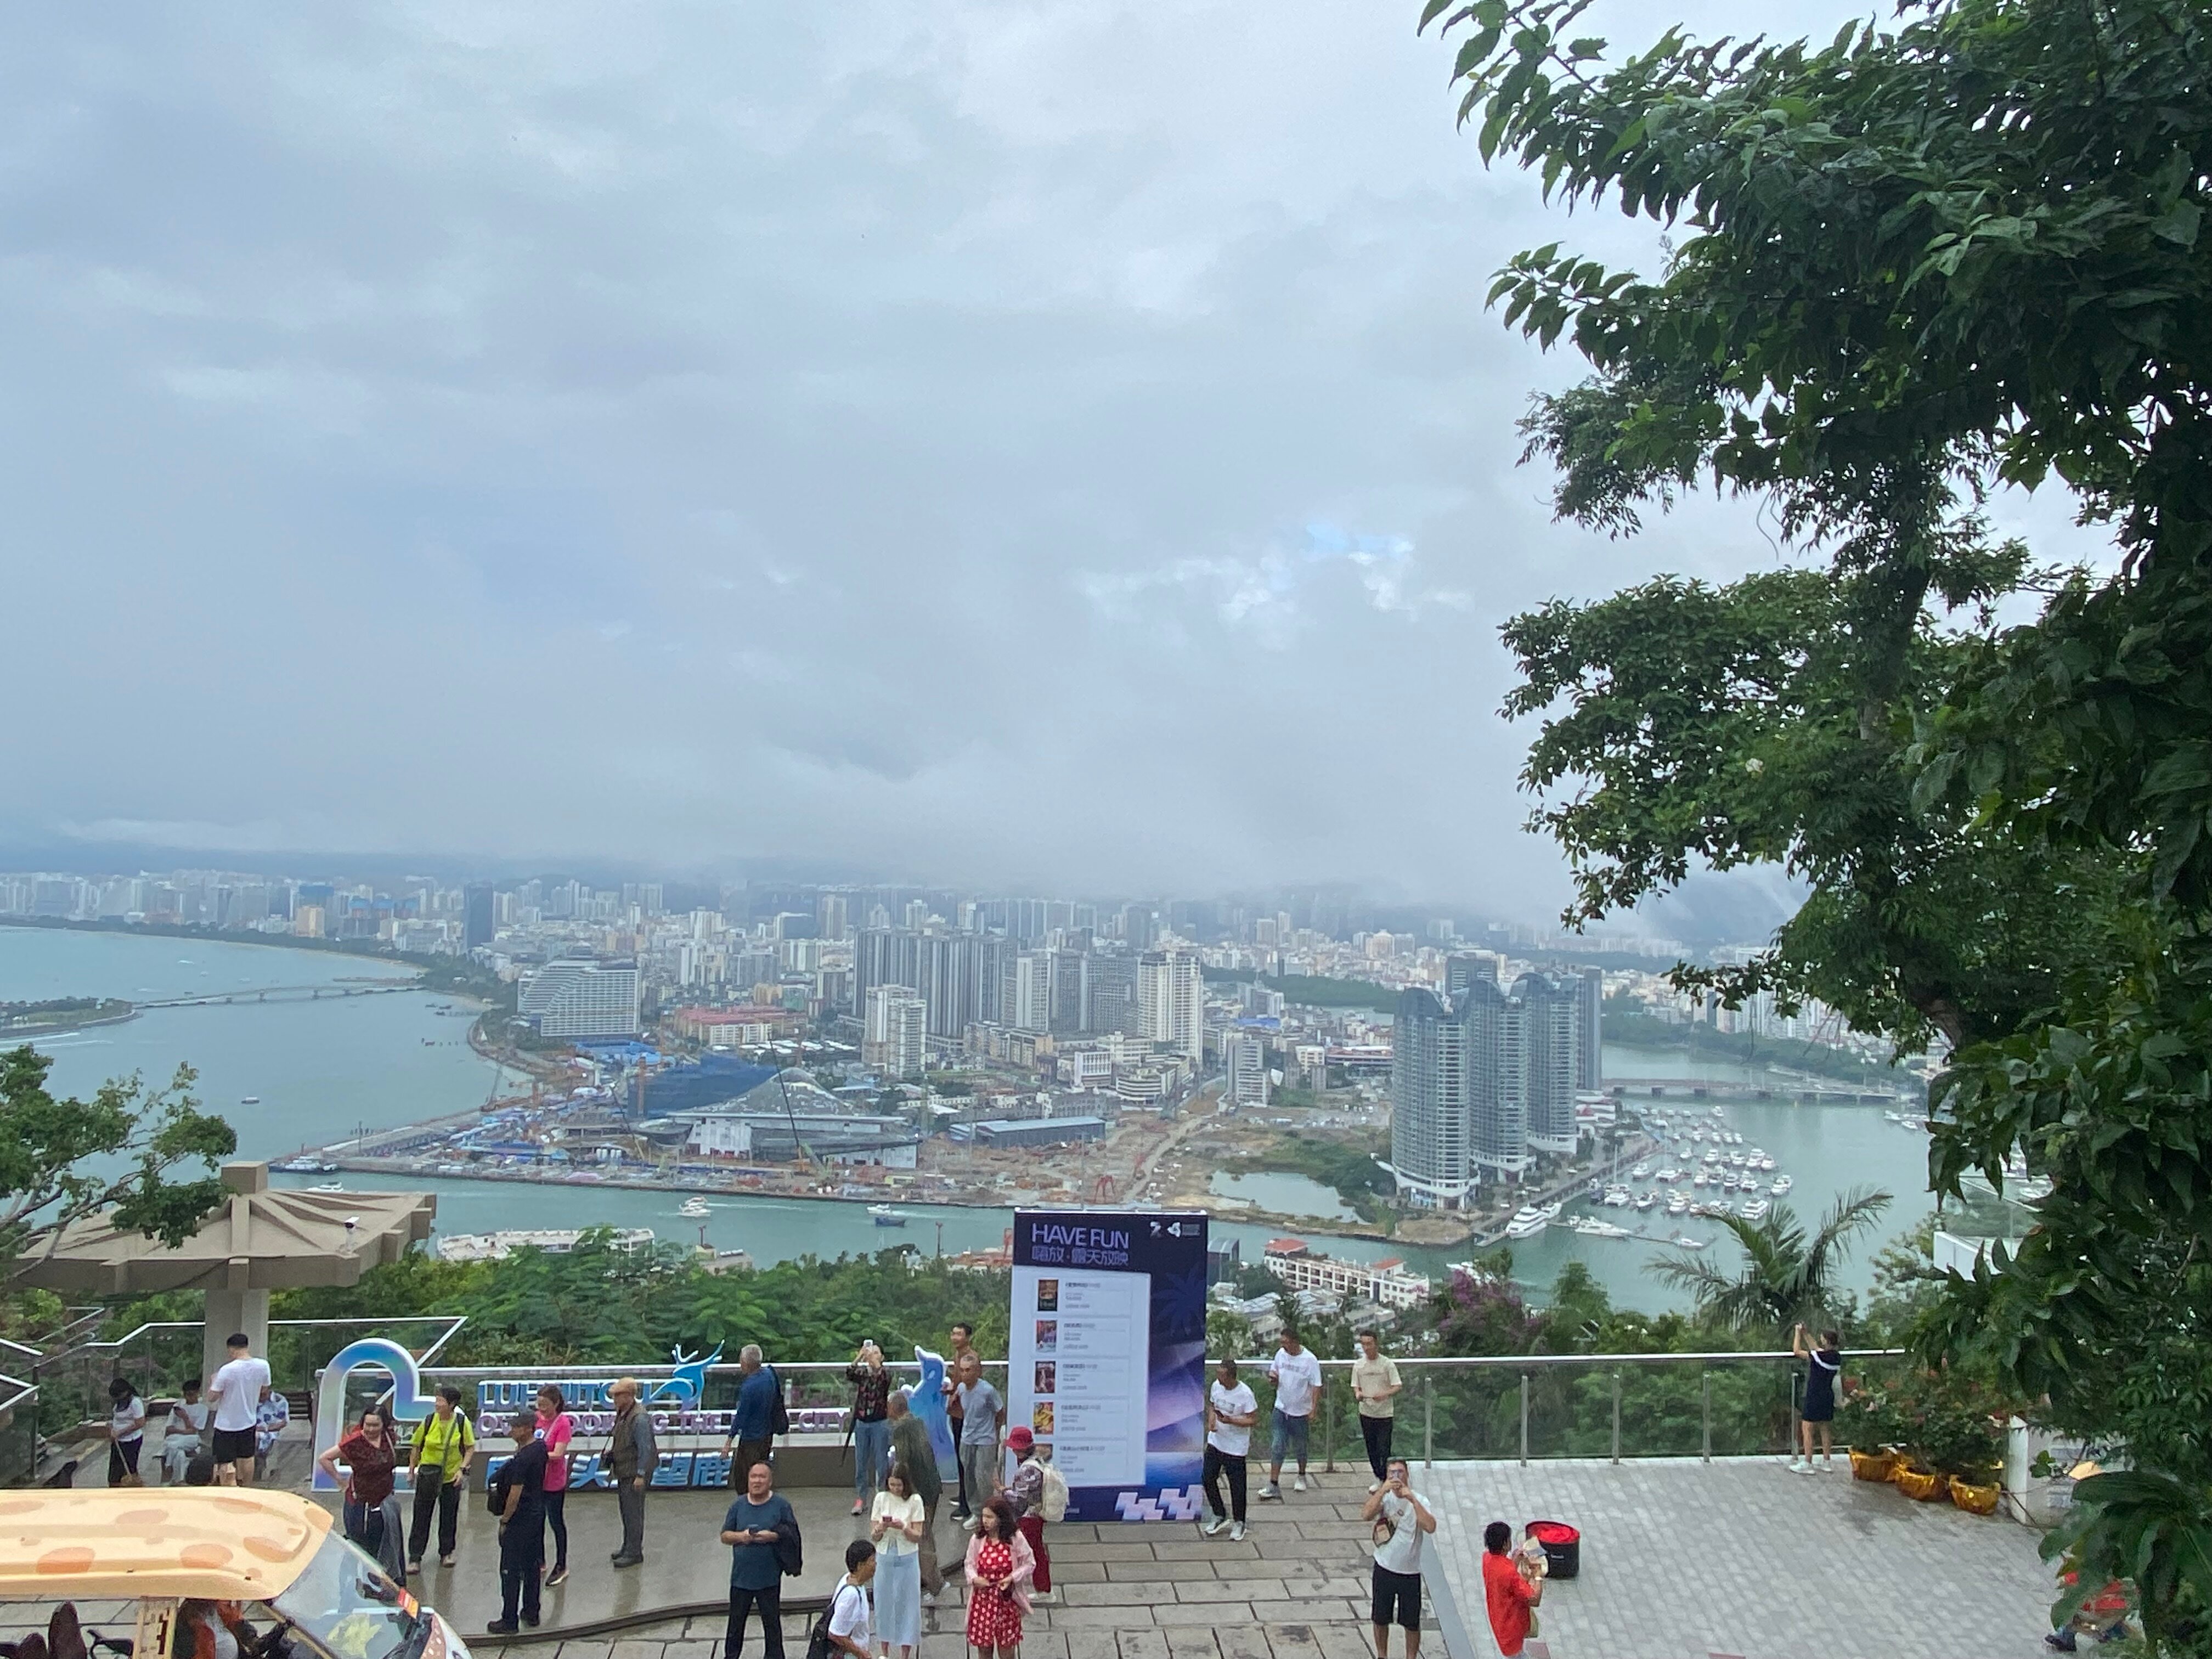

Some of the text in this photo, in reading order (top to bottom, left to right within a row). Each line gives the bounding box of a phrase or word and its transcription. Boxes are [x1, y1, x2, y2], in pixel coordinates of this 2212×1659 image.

[1031, 1222, 1129, 1249] HAVE FUN
[798, 1408, 847, 1432] CITY
